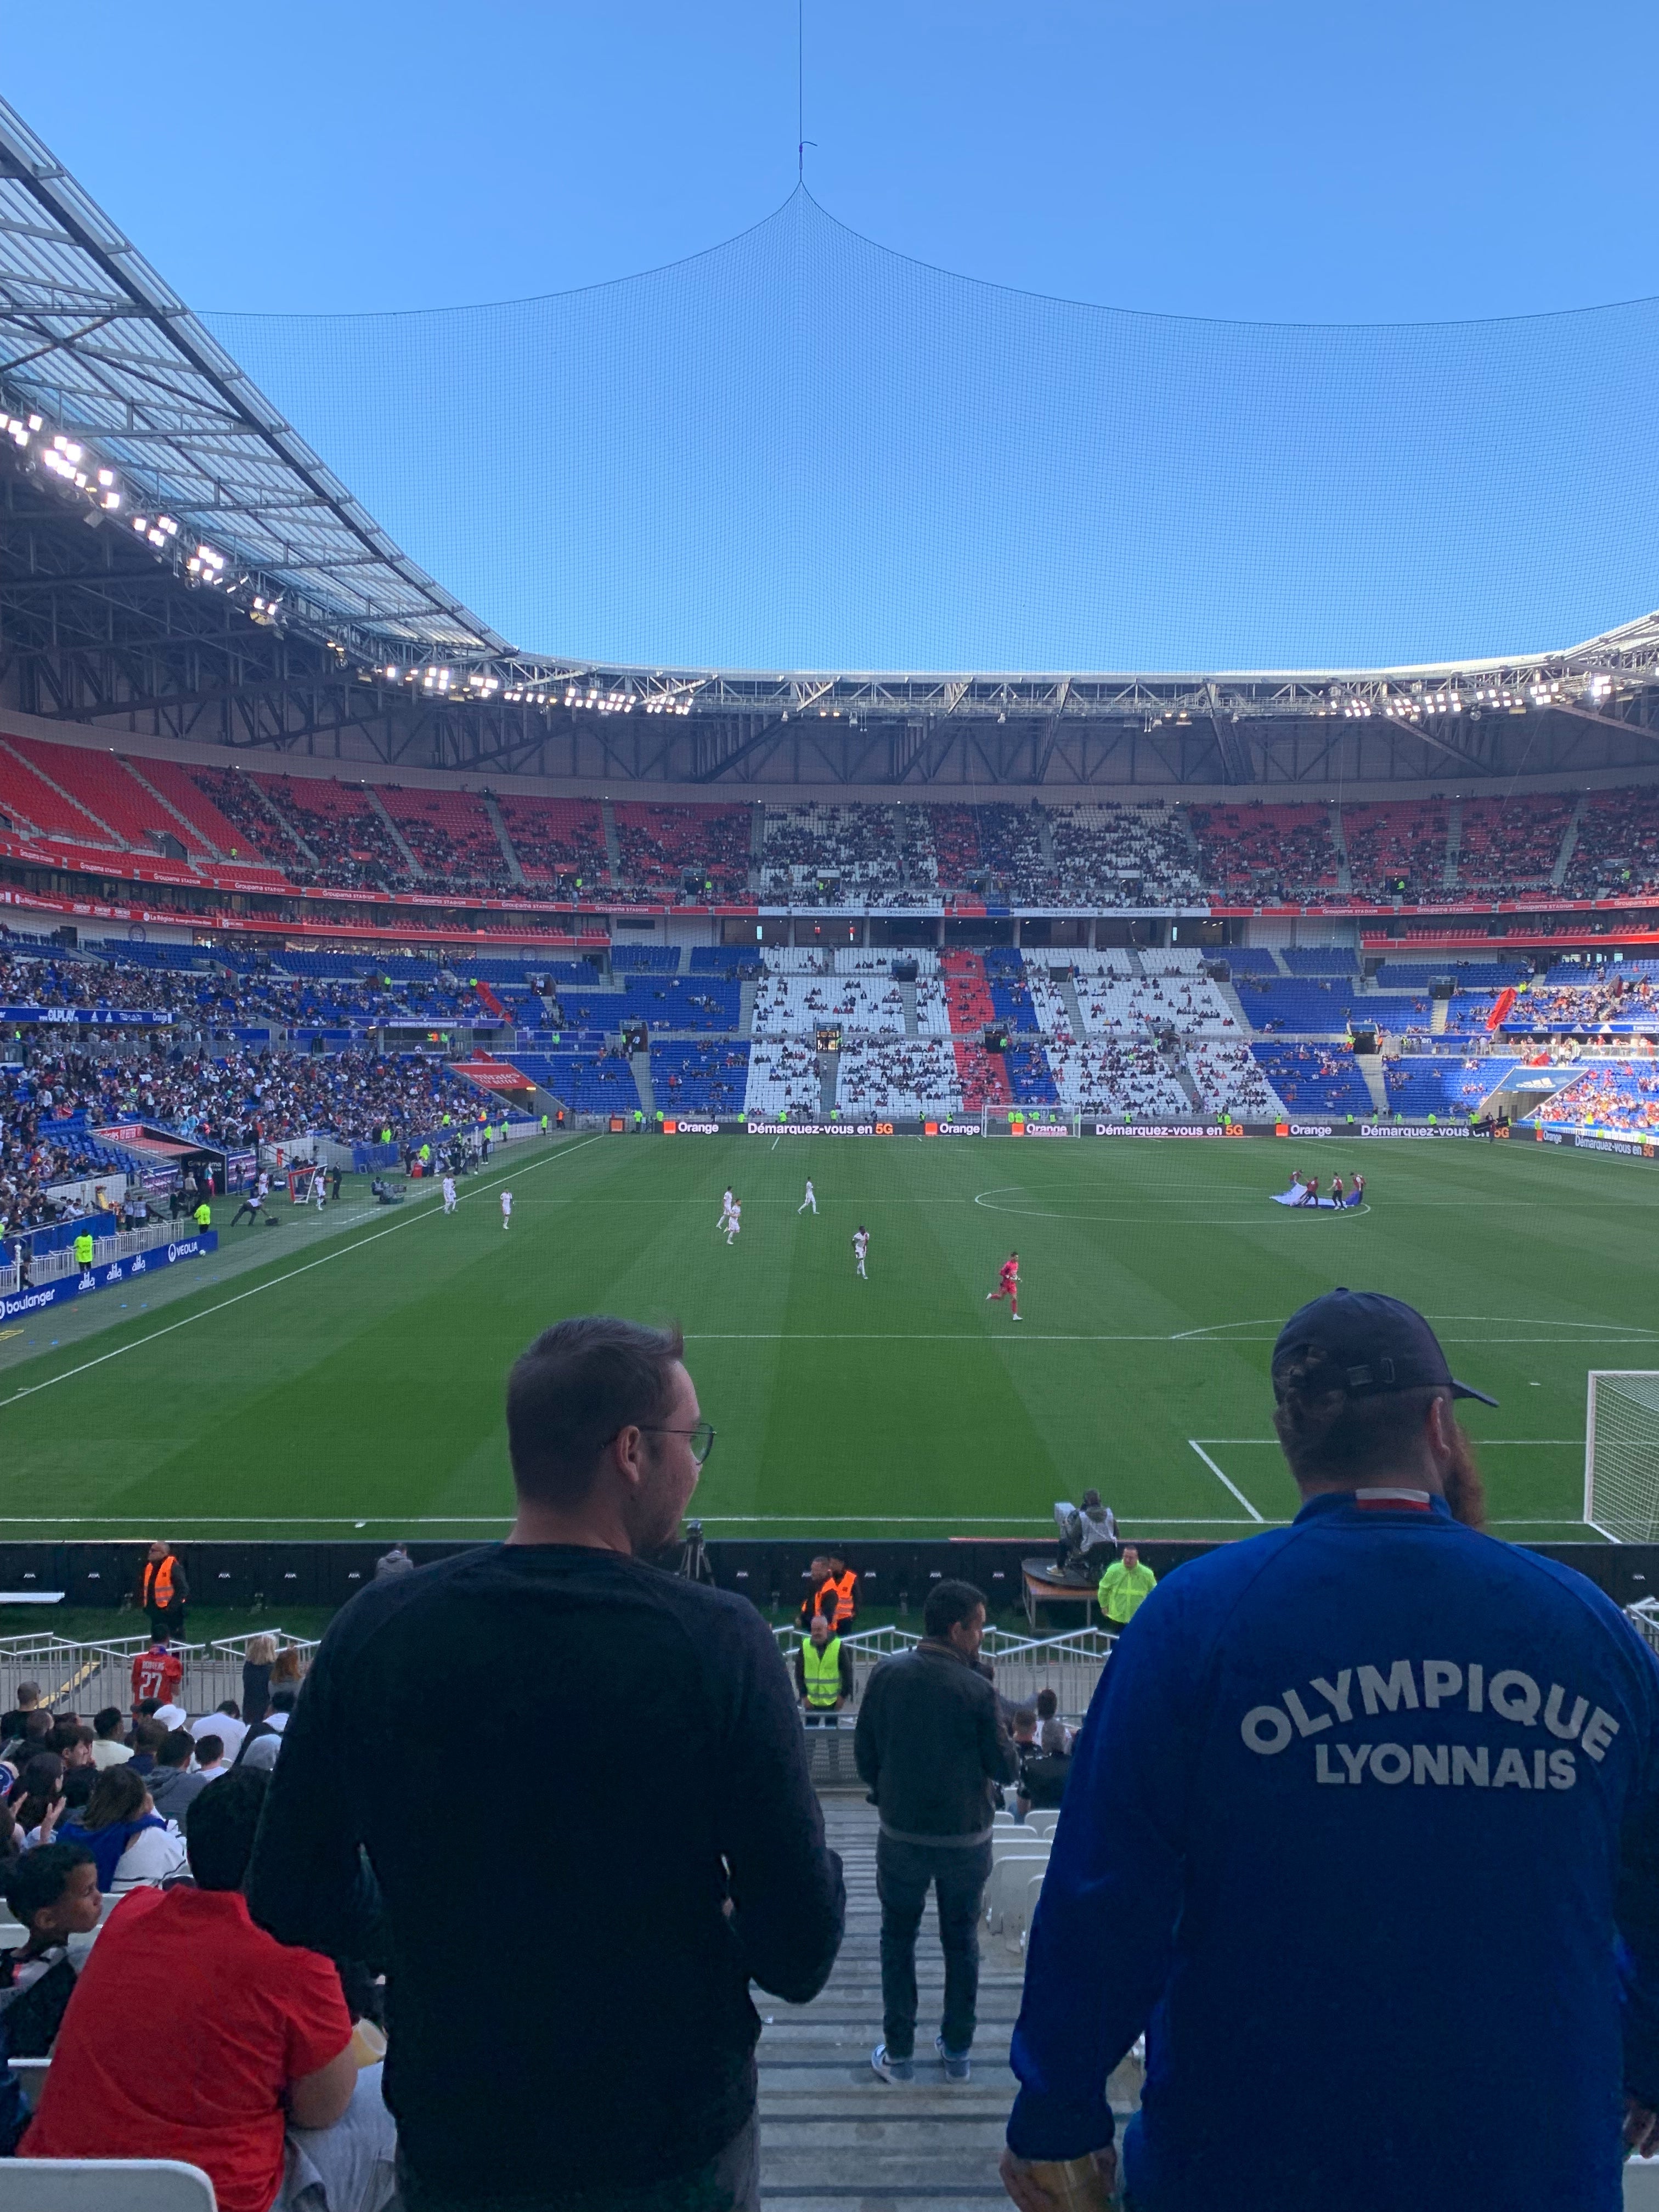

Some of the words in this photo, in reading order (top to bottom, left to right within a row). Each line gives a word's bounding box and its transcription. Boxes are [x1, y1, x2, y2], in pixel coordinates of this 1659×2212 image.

[80, 862, 104, 872] Groupama
[154, 873, 179, 882] Groupama
[235, 883, 263, 891] Groupama
[322, 890, 352, 899] Groupama
[413, 897, 442, 905] Groupama
[159, 915, 174, 923] Région
[678, 1122, 719, 1134] Orange
[748, 1122, 854, 1135] Démarquez-vous
[857, 1125, 872, 1134] en
[876, 1123, 893, 1134] 5G
[940, 1123, 980, 1135] Orange
[1026, 1124, 1067, 1133] Orange
[1096, 1124, 1203, 1136] Démarquez-vous
[1206, 1126, 1222, 1135] en
[1226, 1125, 1243, 1136] 5G
[1290, 1125, 1331, 1137] Orange
[1361, 1125, 1470, 1137] Démarquez-vous
[1543, 1131, 1562, 1144] Orange
[1575, 1135, 1632, 1154] Démarquez-vous
[1633, 1146, 1642, 1156] en
[1643, 1144, 1654, 1158] 5G
[177, 1242, 198, 1256] VEOLIA
[6, 1289, 55, 1314] boulanger
[139, 1672, 162, 1699] 27
[1240, 1660, 1620, 1762] OLYMPIQUE
[1316, 1742, 1577, 1790] LYONNAIS
